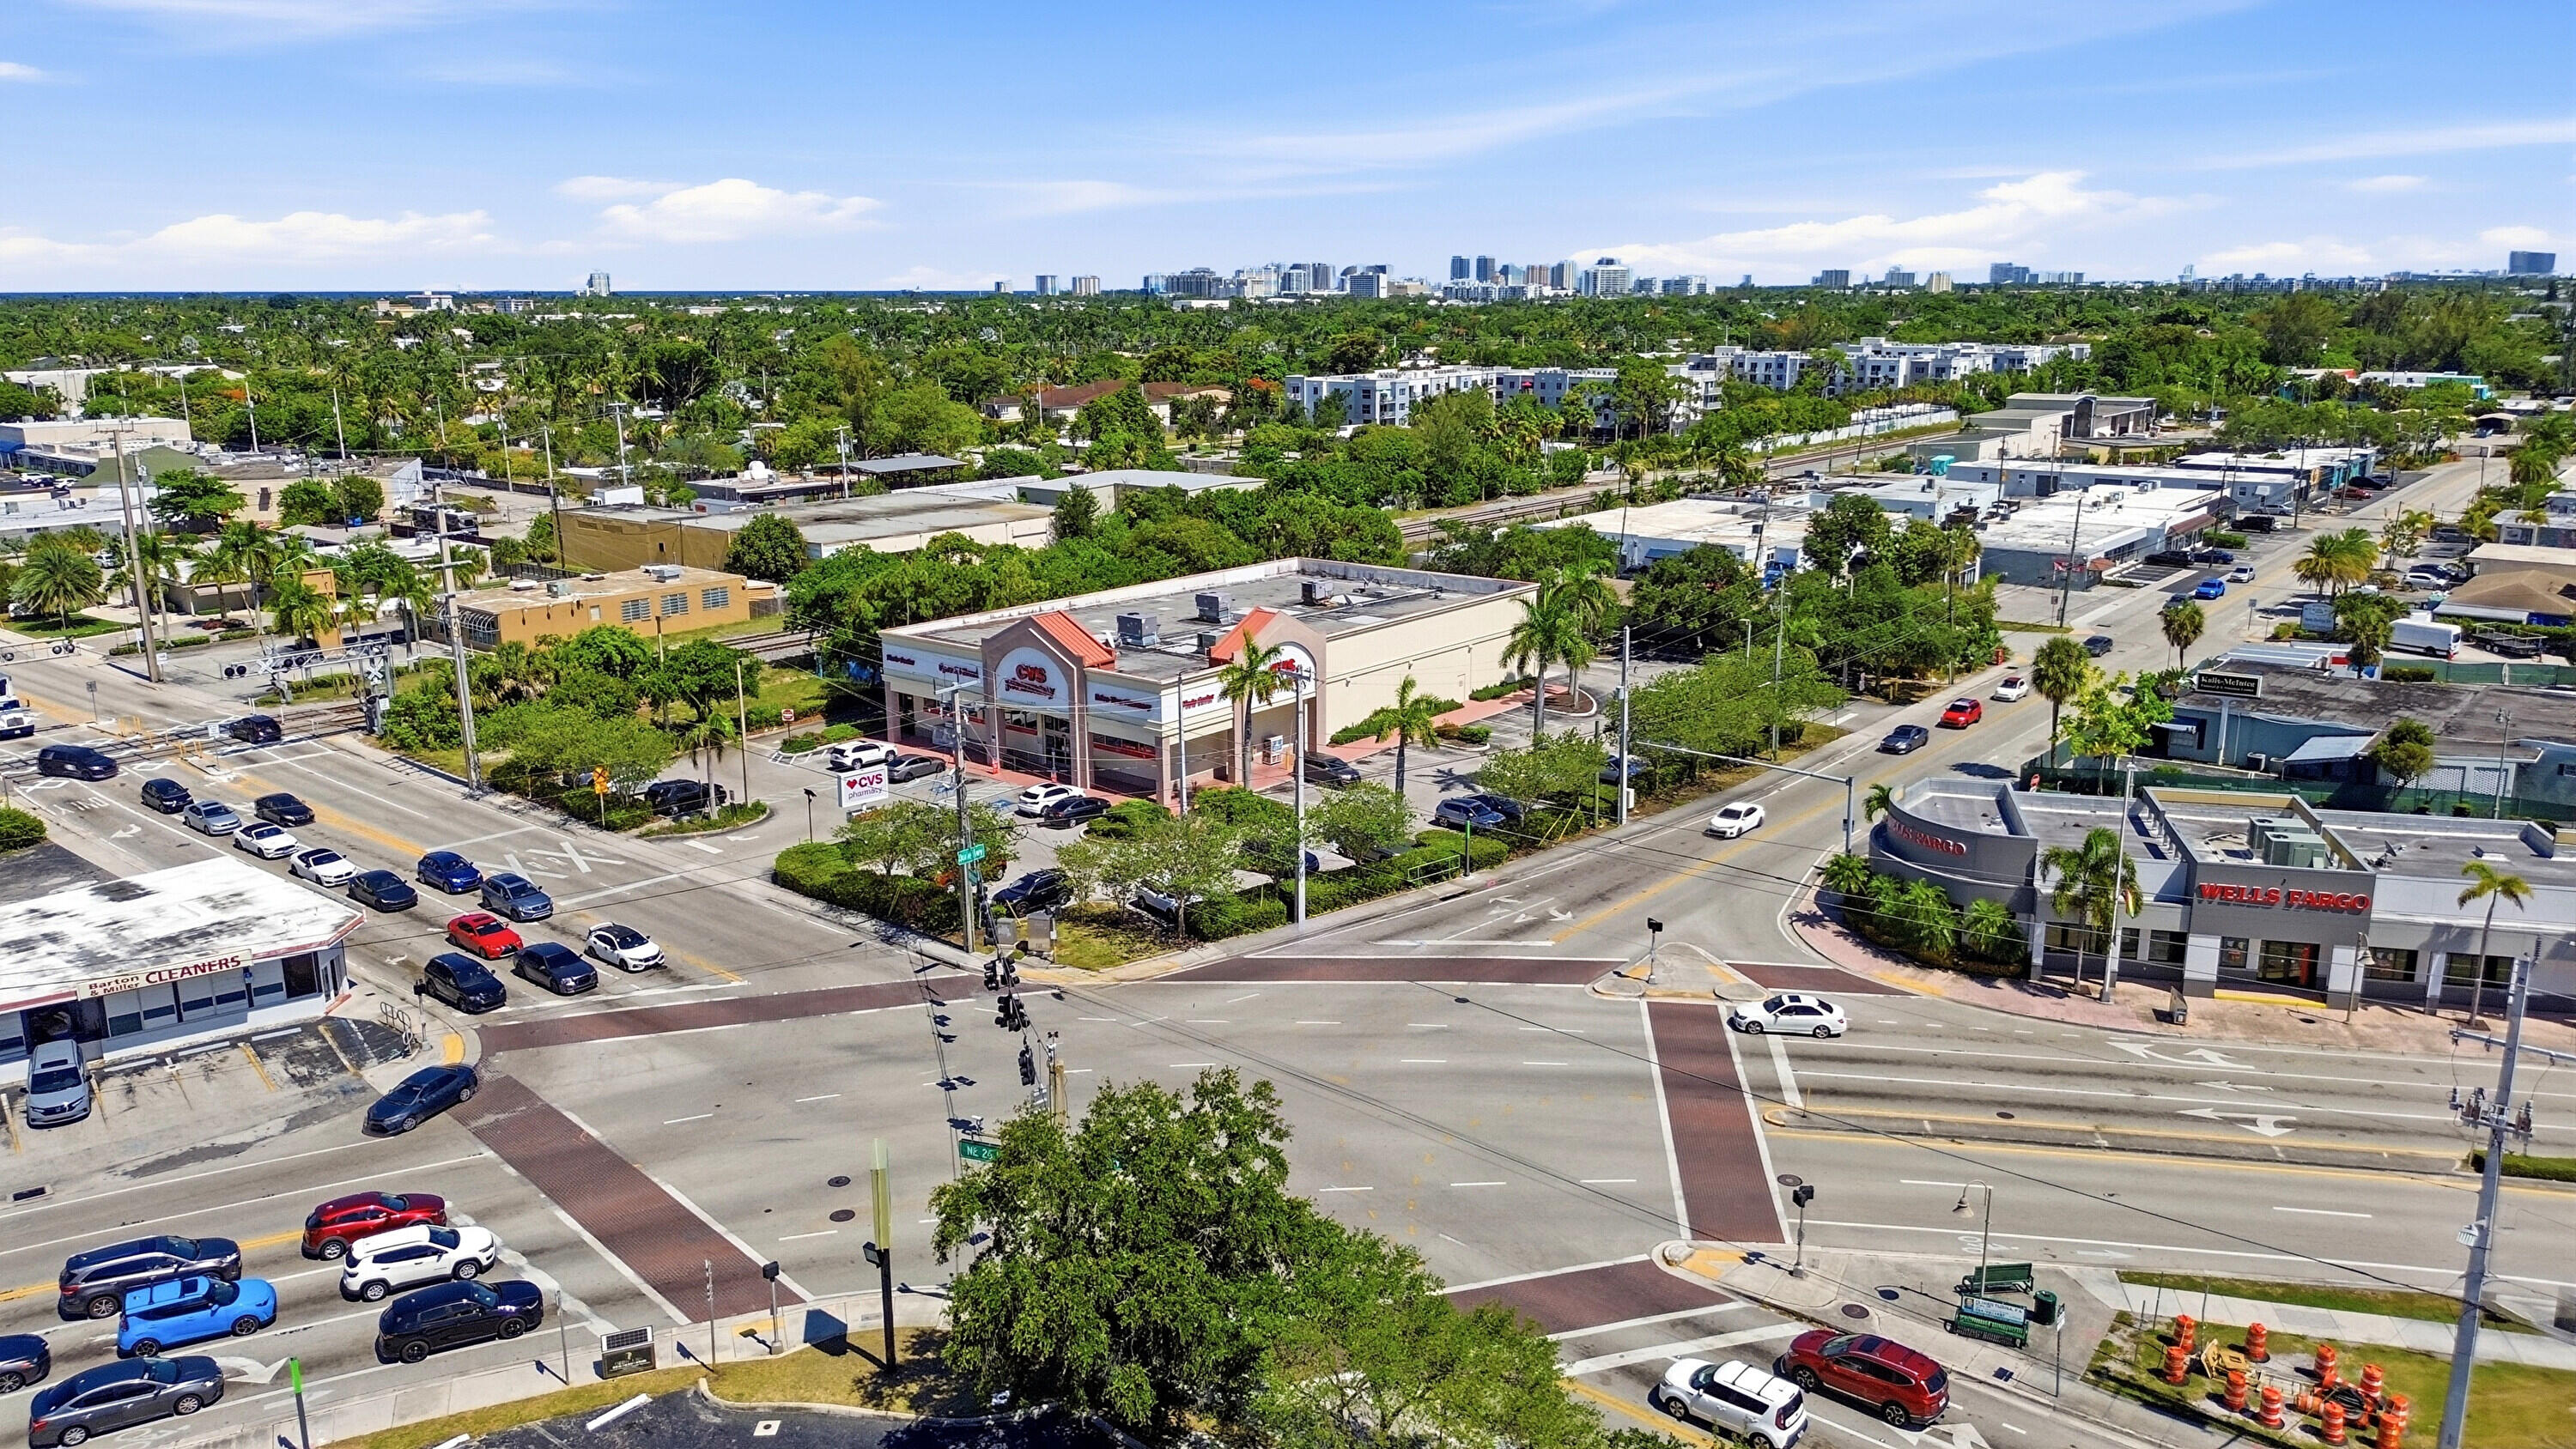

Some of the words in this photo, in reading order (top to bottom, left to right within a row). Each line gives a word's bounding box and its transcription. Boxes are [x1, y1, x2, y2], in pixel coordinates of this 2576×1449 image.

[1016, 664, 1047, 683] CVS
[859, 773, 883, 787] CVS
[848, 787, 882, 800] pharmacy
[1916, 830, 1966, 856] FARGO
[2199, 882, 2281, 903] WELLS
[2287, 888, 2370, 910] FARGO
[145, 955, 241, 985] CLEANERS
[88, 975, 139, 990] Barton
[103, 982, 140, 994] Miller
[967, 1145, 979, 1157] NE
